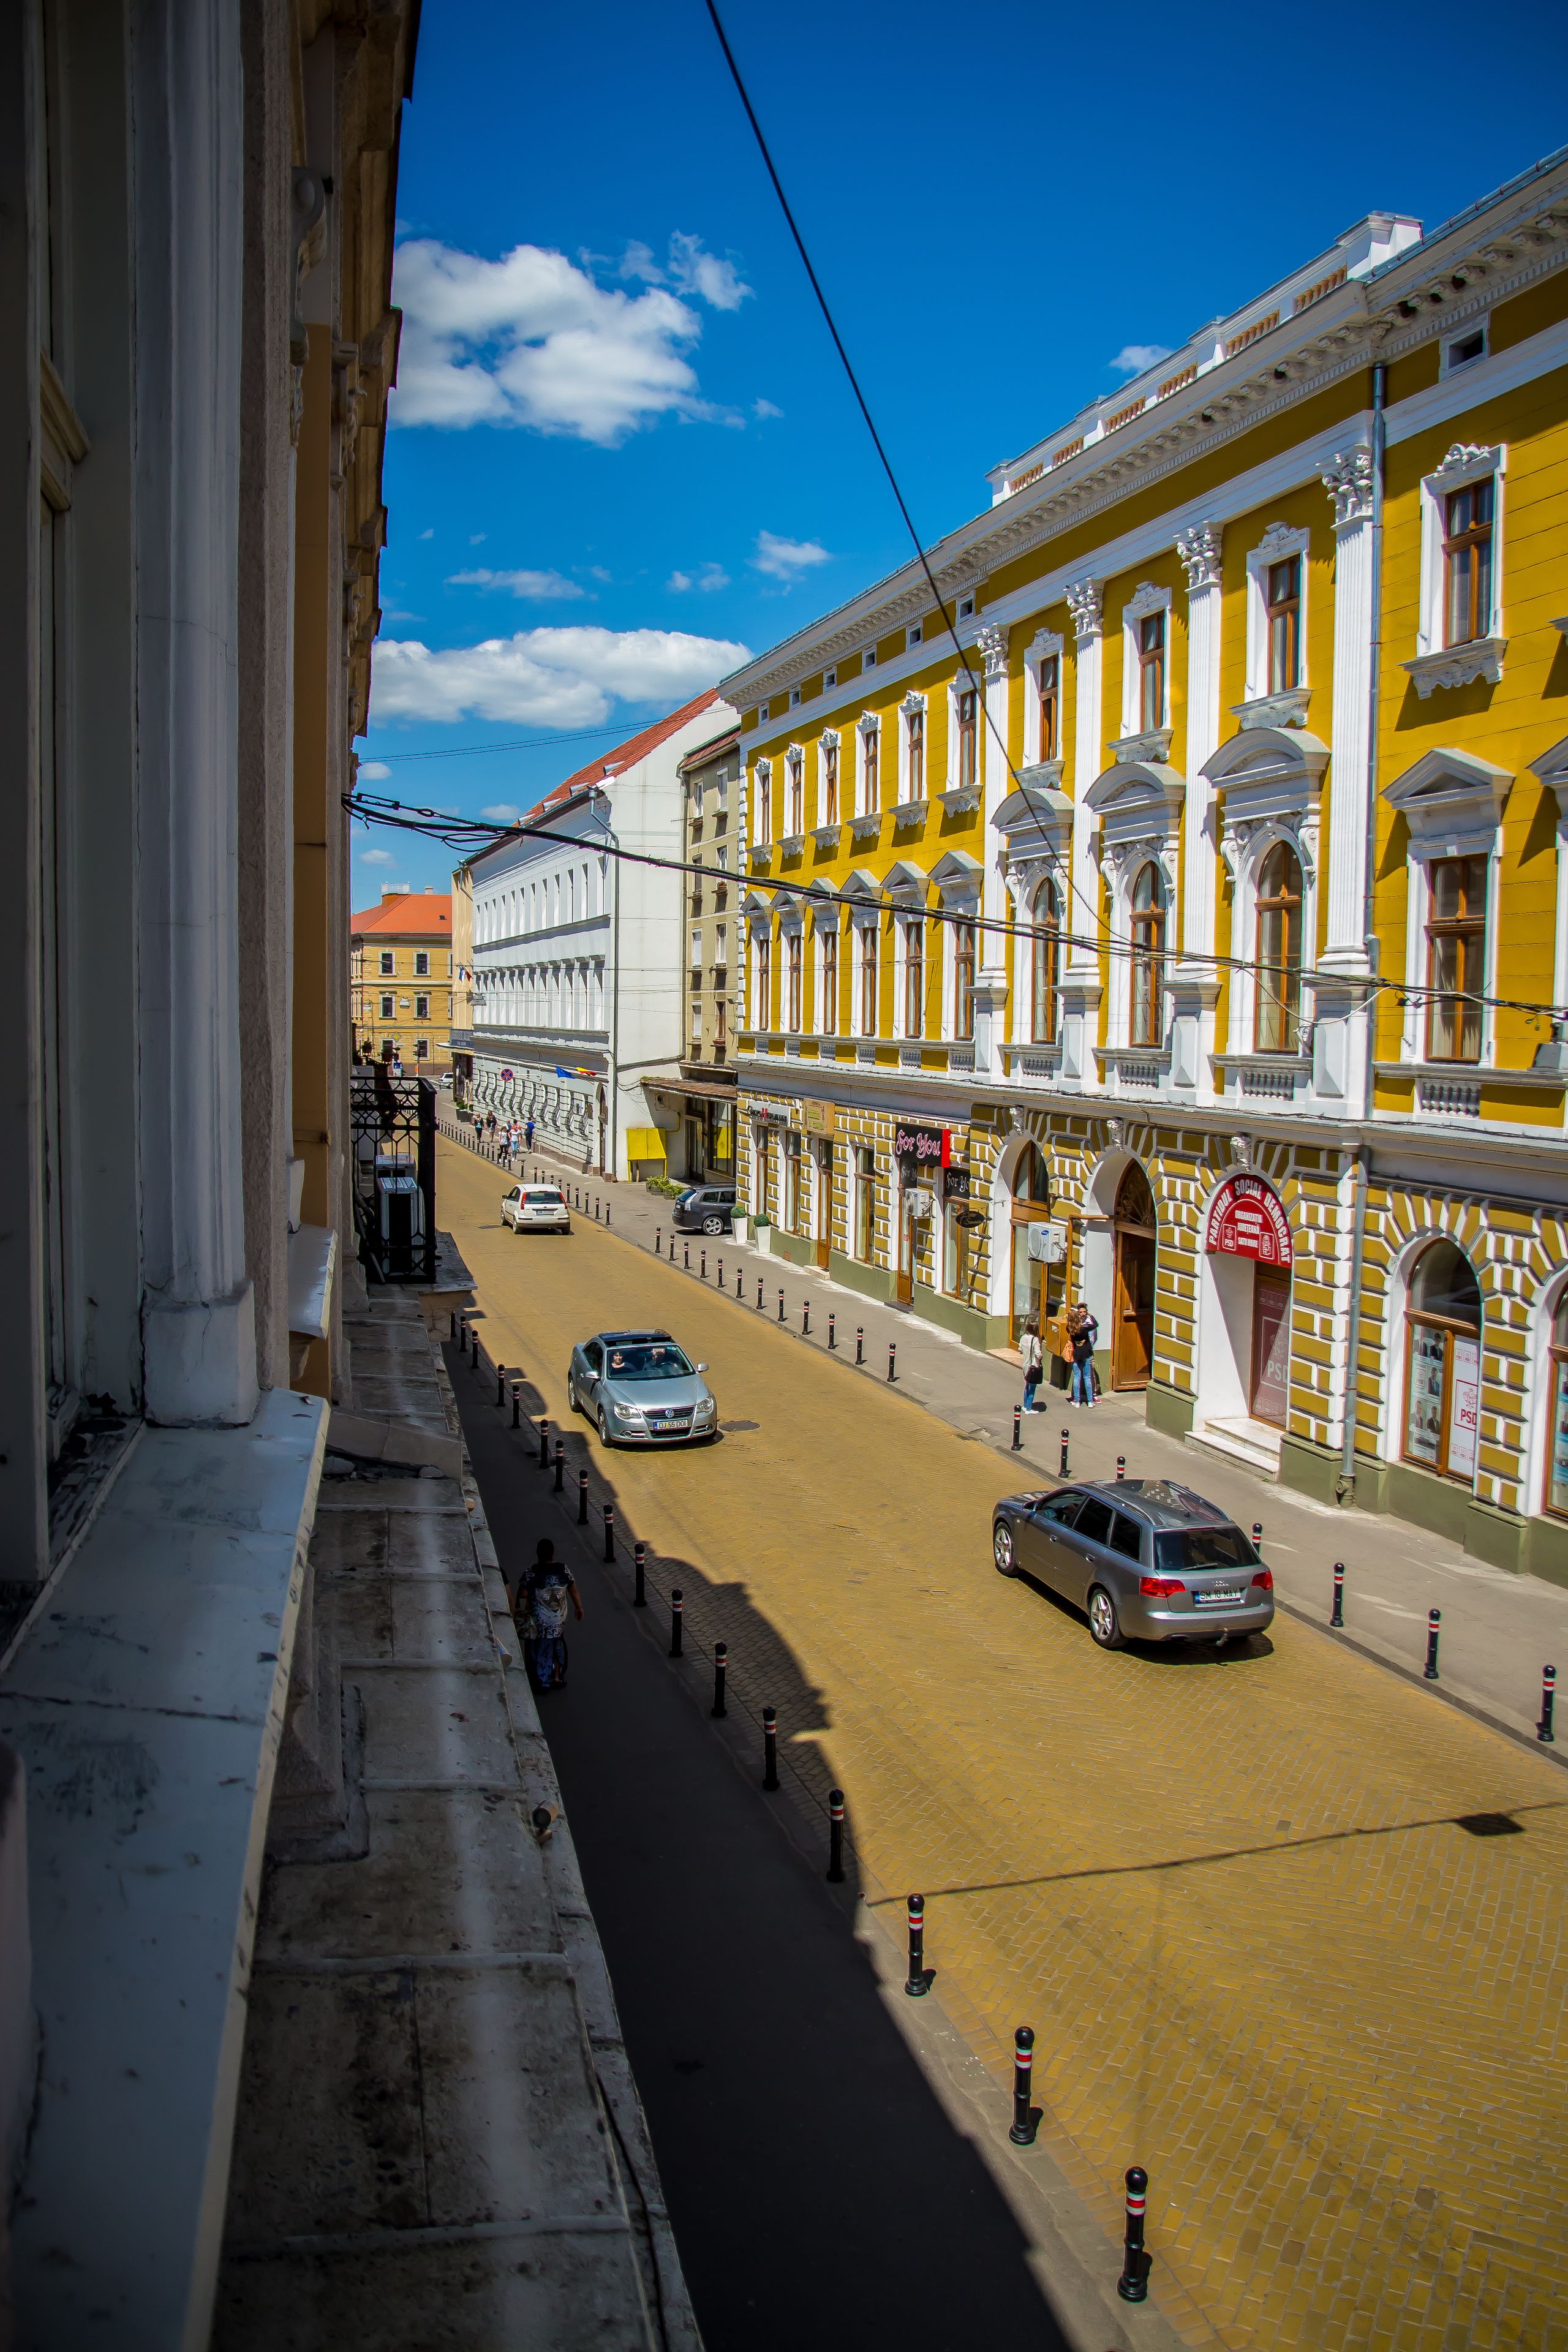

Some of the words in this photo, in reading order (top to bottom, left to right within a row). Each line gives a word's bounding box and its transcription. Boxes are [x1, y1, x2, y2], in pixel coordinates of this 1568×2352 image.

[896, 1129, 915, 1155] For
[916, 1133, 941, 1159] You
[946, 1172, 959, 1189] For
[1208, 1189, 1233, 1245] PARTIDUL
[1234, 1179, 1262, 1200] SOCIAL
[1264, 1192, 1291, 1263] DEMOCRAT
[1225, 1238, 1234, 1247] PSD
[1200, 1590, 1211, 1599] SM
[1213, 1589, 1221, 1598] 10
